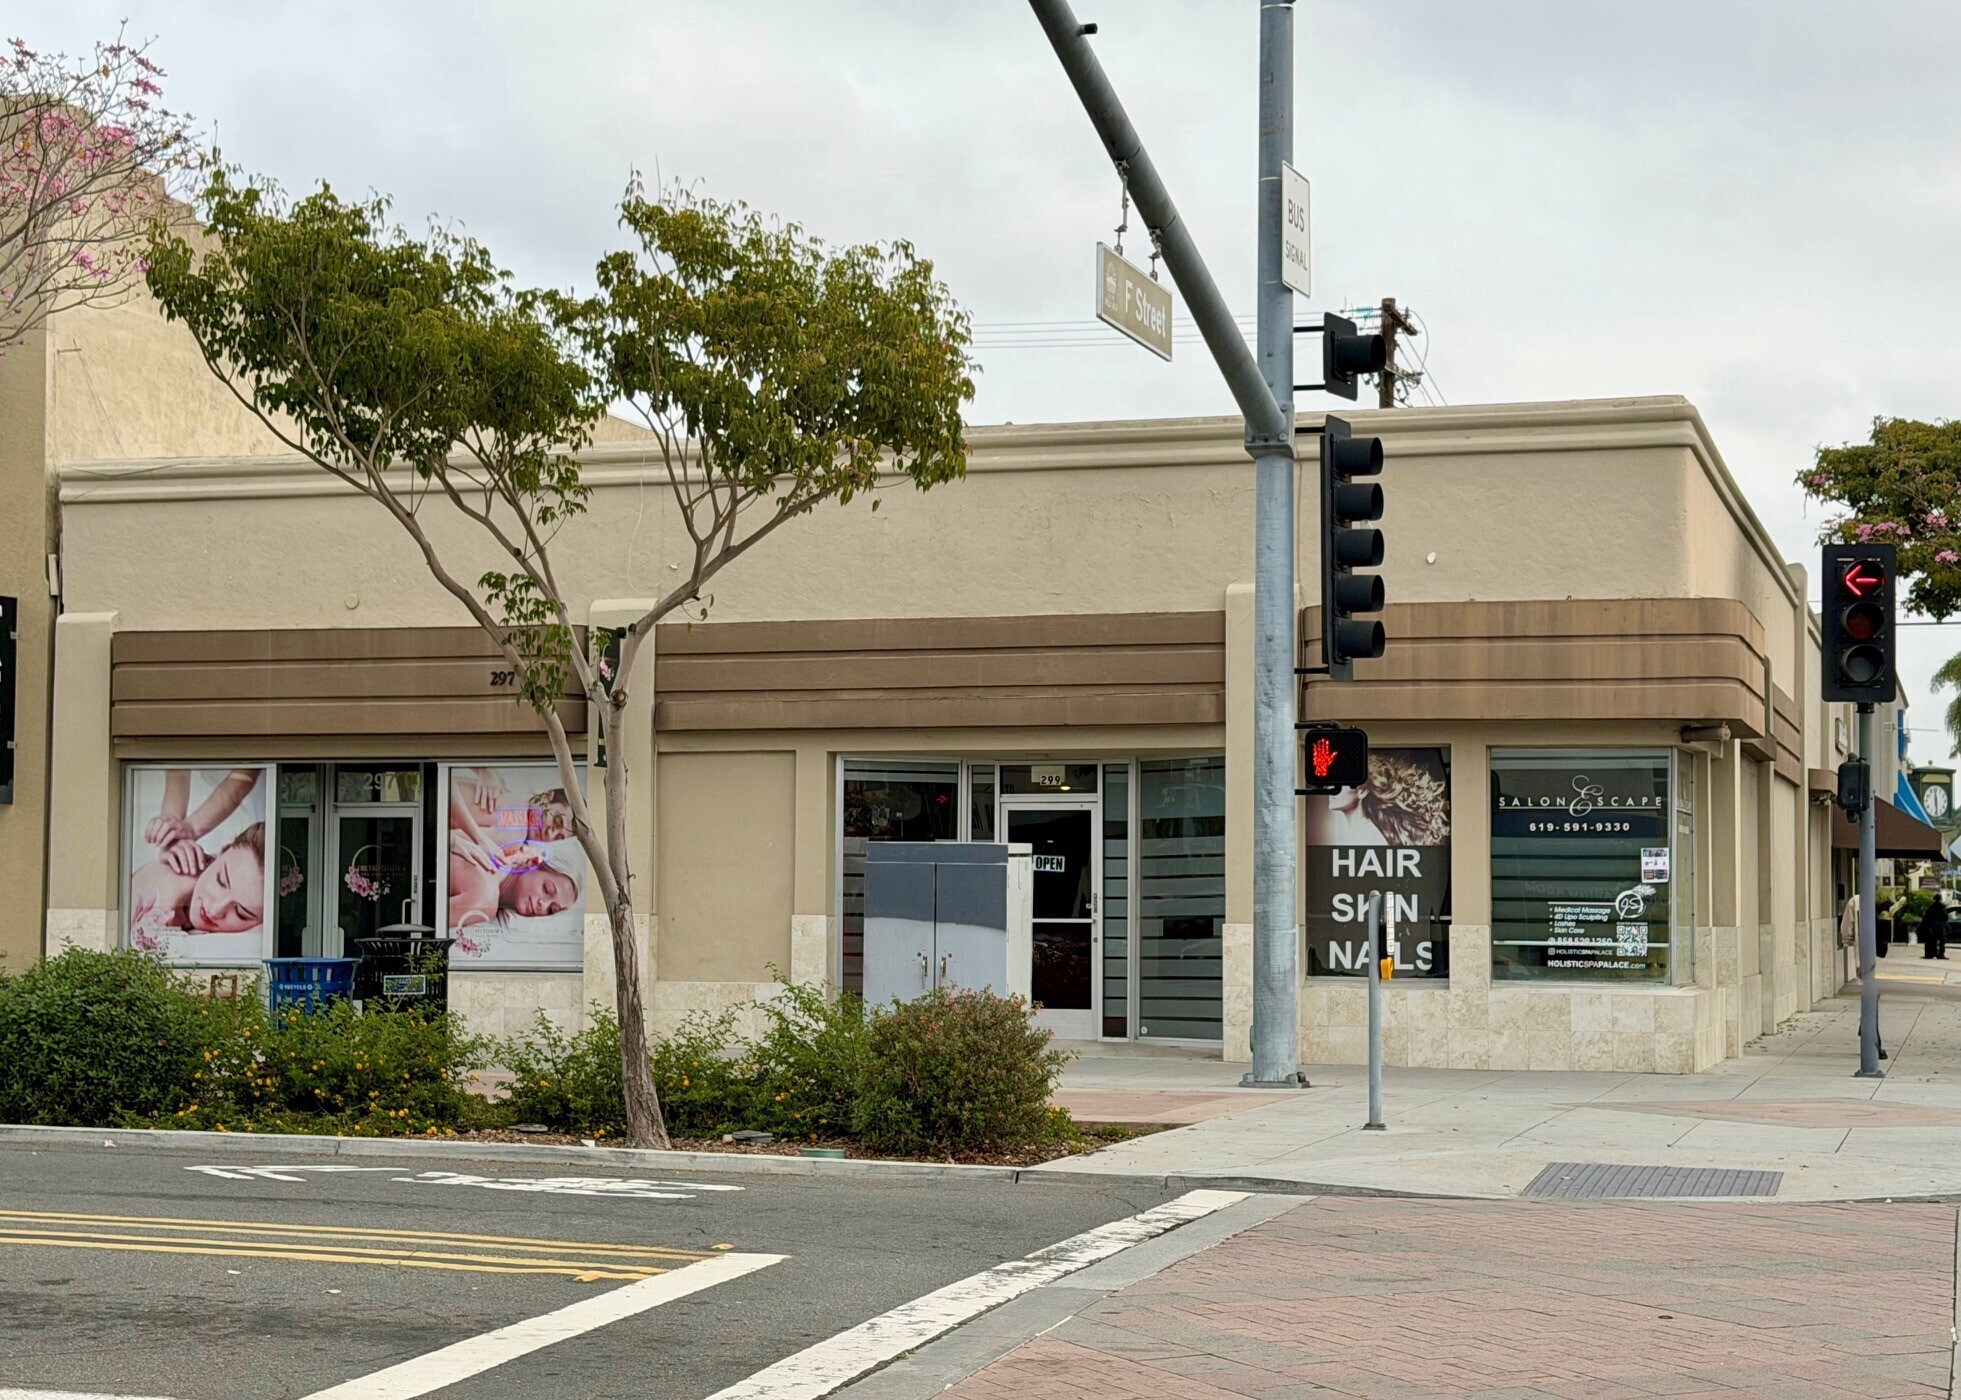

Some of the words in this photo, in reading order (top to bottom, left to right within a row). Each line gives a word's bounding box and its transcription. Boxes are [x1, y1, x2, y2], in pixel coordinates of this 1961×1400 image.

[1288, 198, 1305, 233] BUS
[1285, 240, 1308, 271] SIGNAL
[1125, 279, 1133, 313] F
[1135, 287, 1166, 338] Street
[490, 671, 516, 687] 297
[362, 772, 397, 790] 297
[1040, 775, 1062, 785] 299
[1498, 797, 1566, 807] SALON
[1035, 856, 1063, 870] OPEN
[1332, 848, 1423, 878] HAIR
[1331, 893, 1418, 923] SKN
[1553, 906, 1580, 914] Medical
[1581, 906, 1611, 914] Massage
[1564, 913, 1578, 921] Lipo
[1578, 914, 1609, 922] Sculpting
[1329, 940, 1433, 971] NALS
[1547, 960, 1647, 970] HOLISTICSPAPALACE.com
